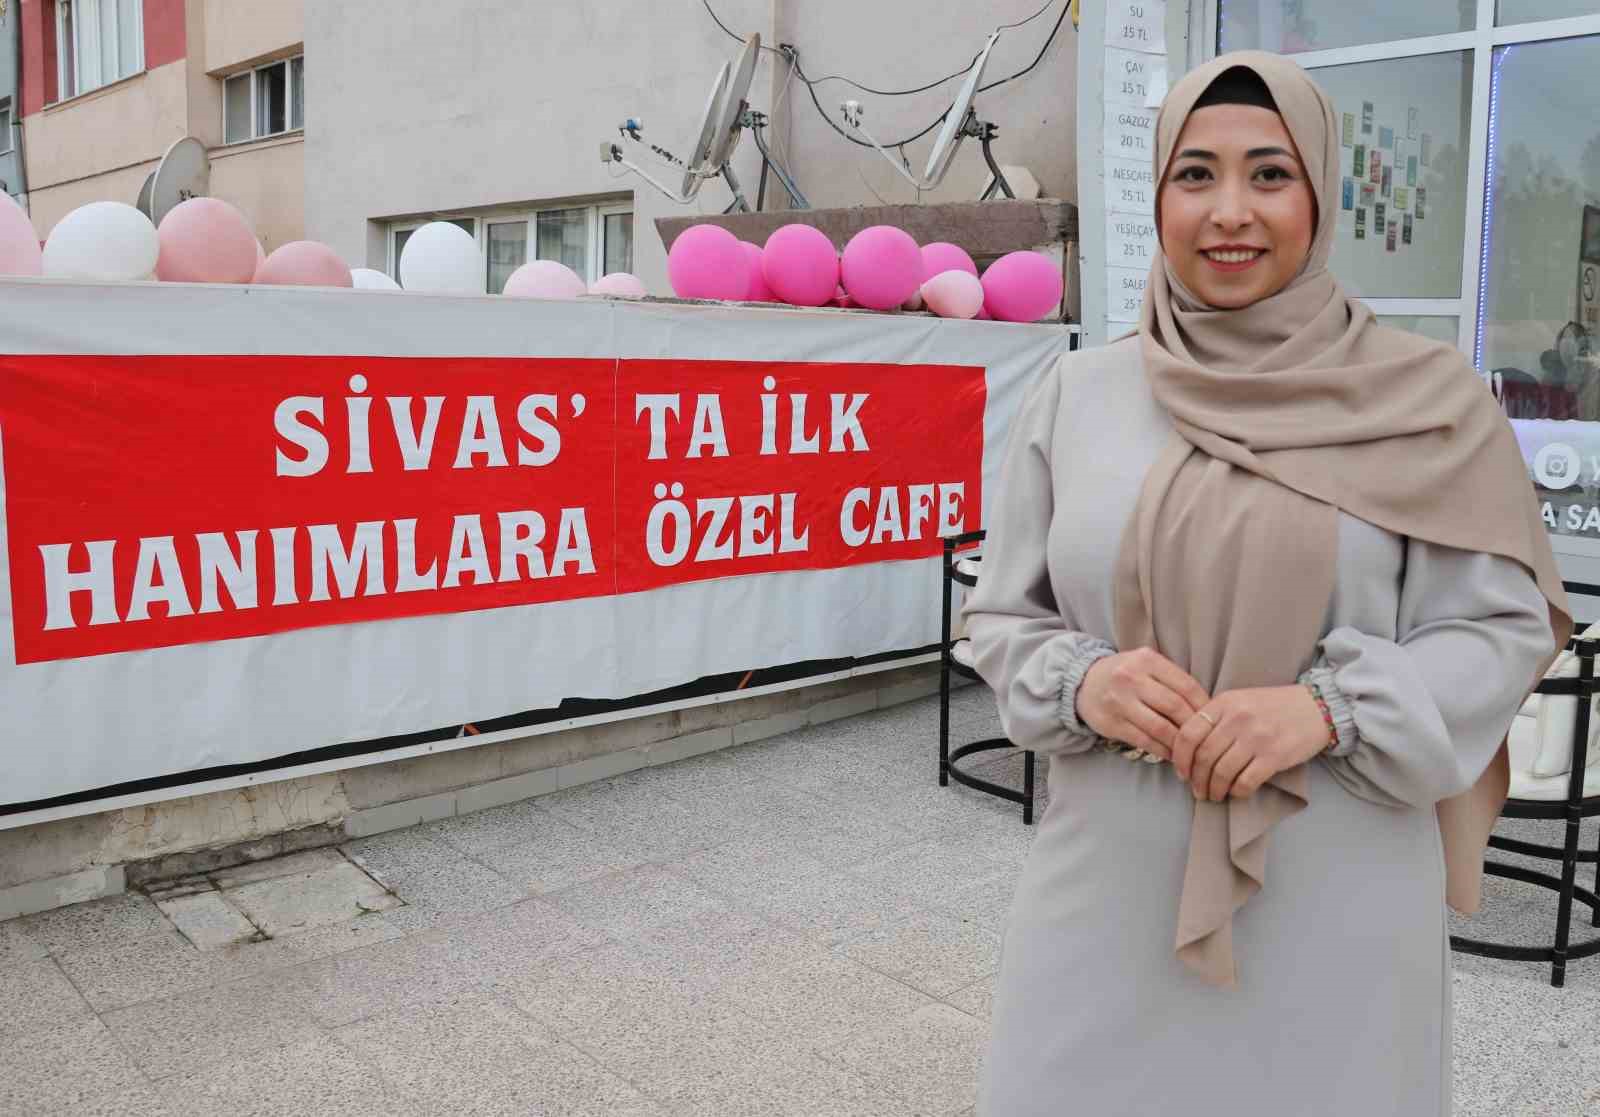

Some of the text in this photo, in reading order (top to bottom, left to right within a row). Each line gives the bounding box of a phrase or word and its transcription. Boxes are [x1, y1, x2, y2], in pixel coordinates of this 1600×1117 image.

[1129, 6, 1143, 18] SU
[1123, 25, 1149, 41] 15 TL
[1125, 61, 1144, 75] ÇAY
[1121, 82, 1147, 97] 15 TL
[1118, 114, 1152, 129] GAZOZ
[1120, 135, 1147, 149] 20 TL
[1121, 189, 1146, 203] 25 TL
[1123, 243, 1148, 257] 25 TL
[1123, 298, 1136, 310] 25
[635, 393, 730, 460] TA
[759, 375, 870, 456] İLK
[38, 481, 966, 631] HANIMLARA ÖZEL CAFE
